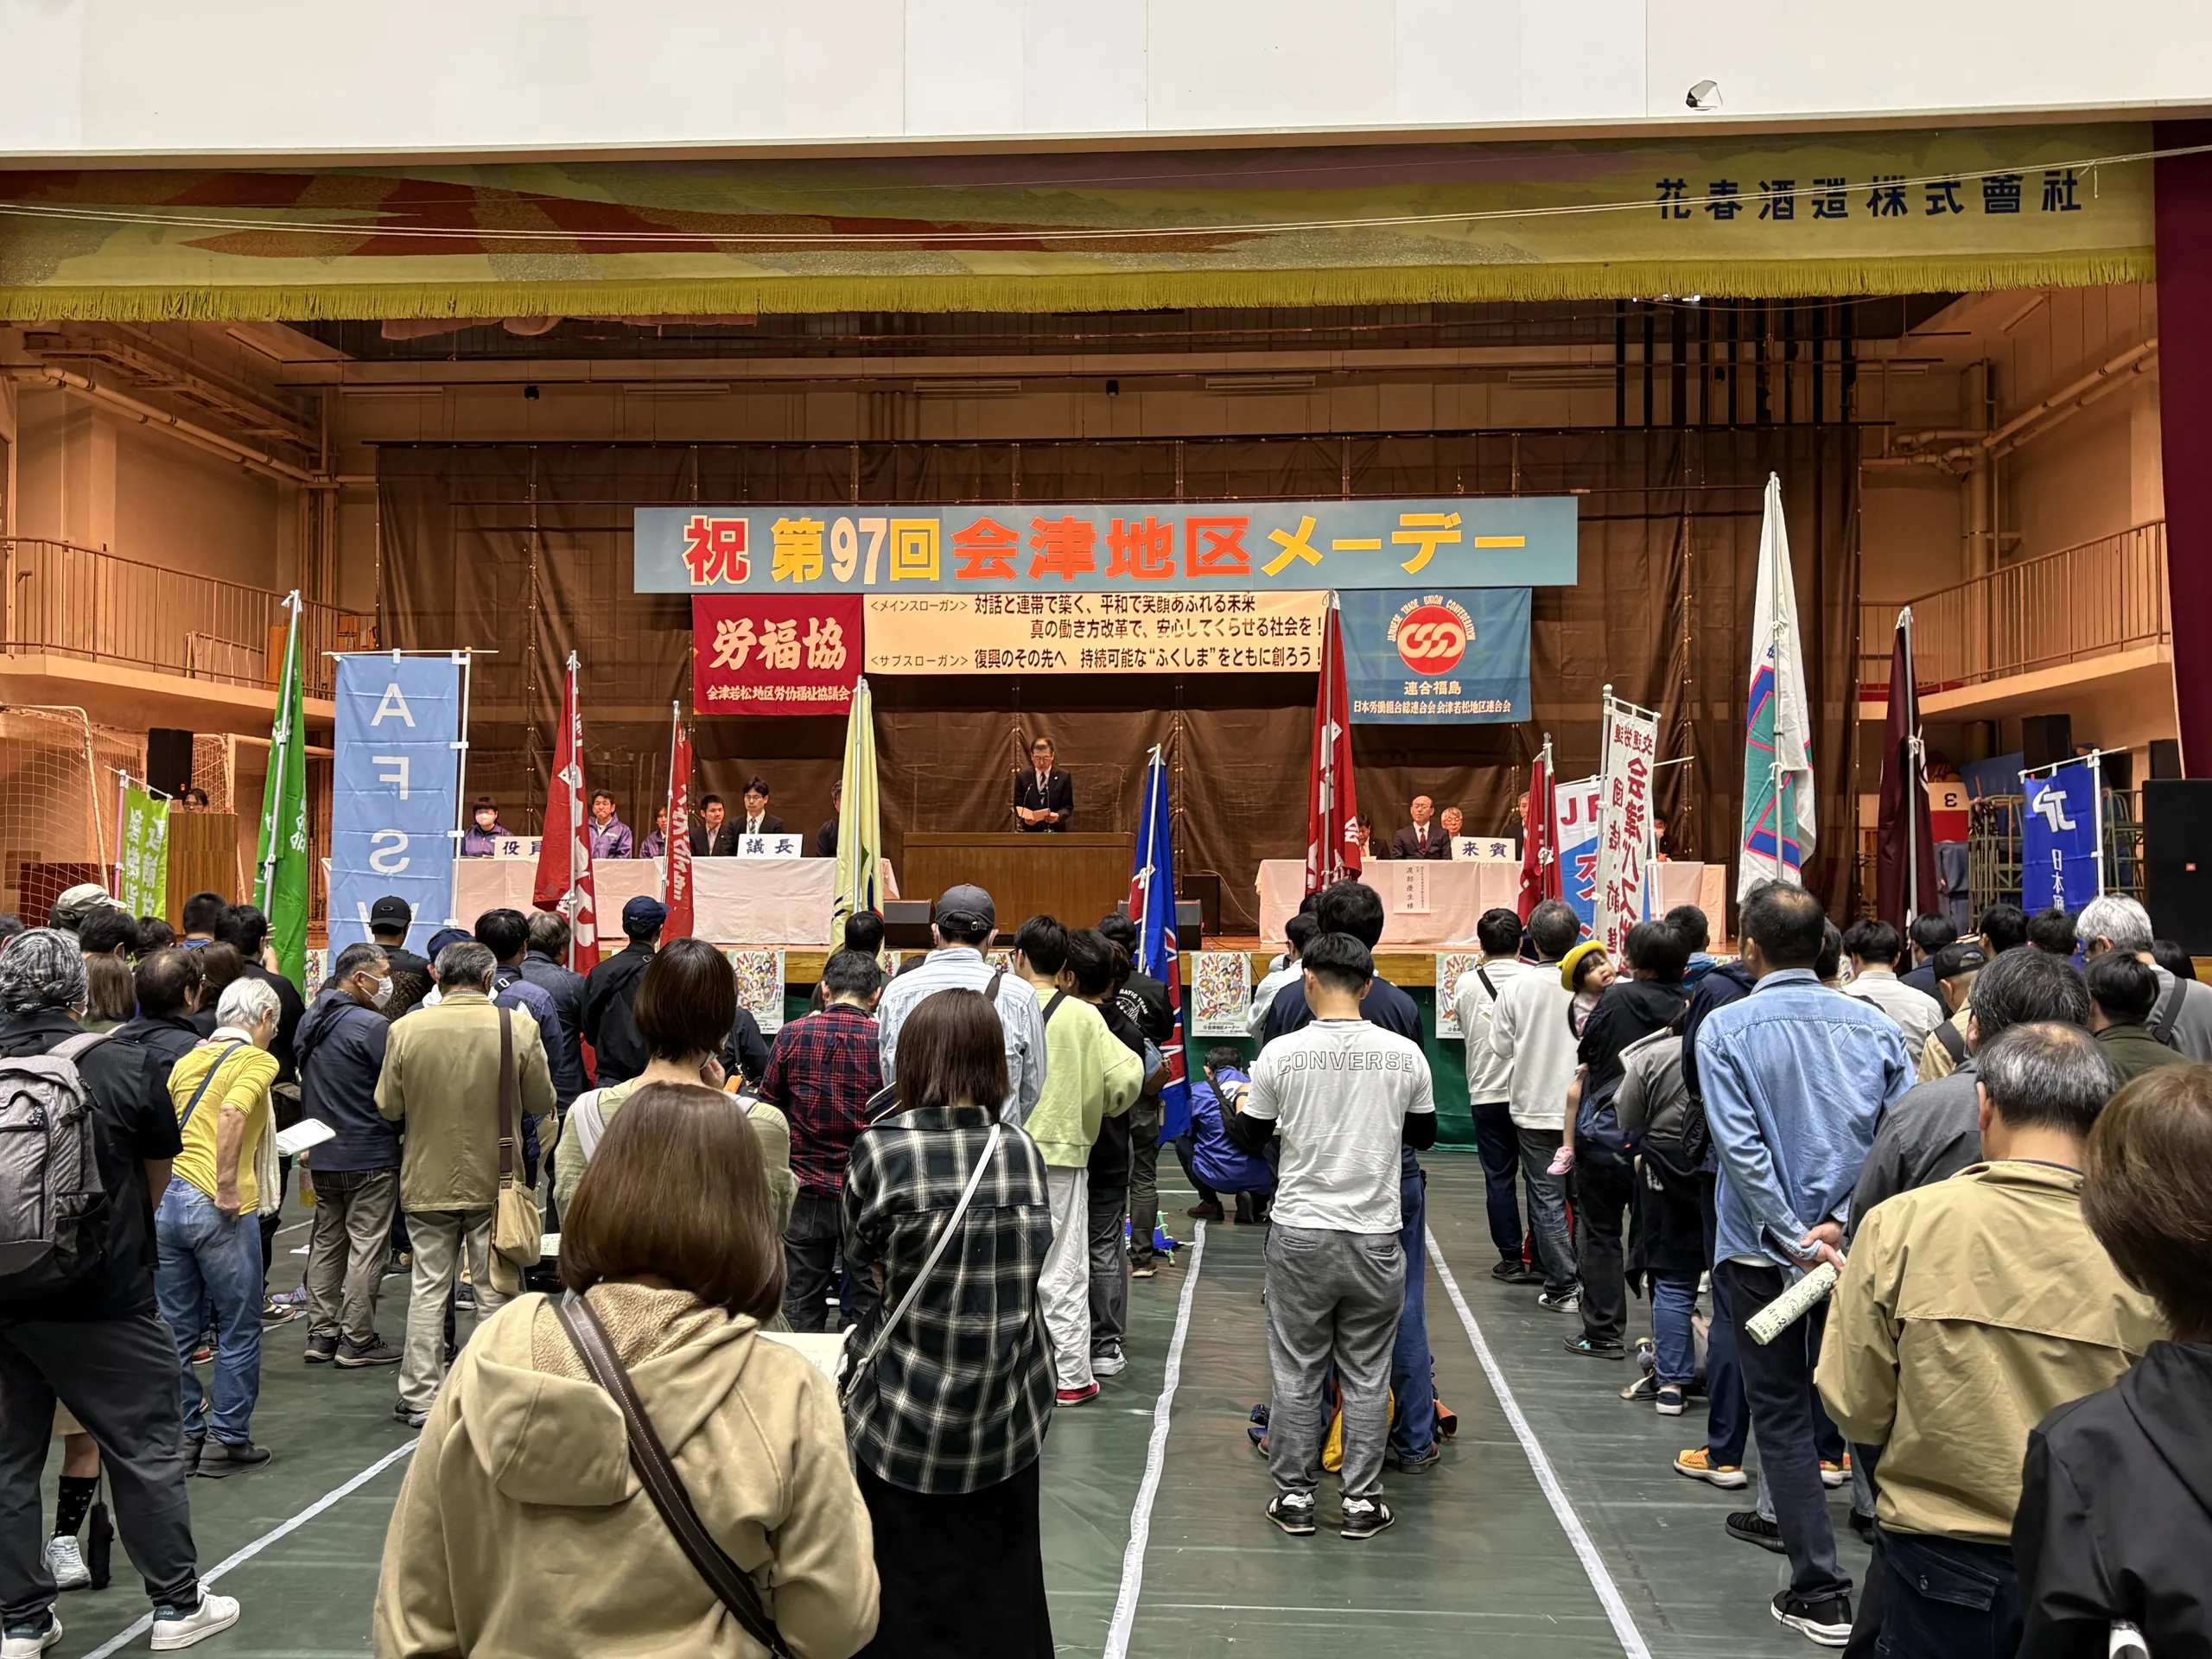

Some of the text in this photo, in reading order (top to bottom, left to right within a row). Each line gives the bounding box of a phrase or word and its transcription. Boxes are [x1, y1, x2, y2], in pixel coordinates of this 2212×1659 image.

[1401, 598, 1420, 615] TRADE
[1423, 594, 1444, 606] UNION
[709, 617, 848, 671] 労福協
[1403, 680, 1462, 696] 連合福島
[746, 837, 794, 855] 議長
[1277, 1050, 1414, 1076] CONVERSE
